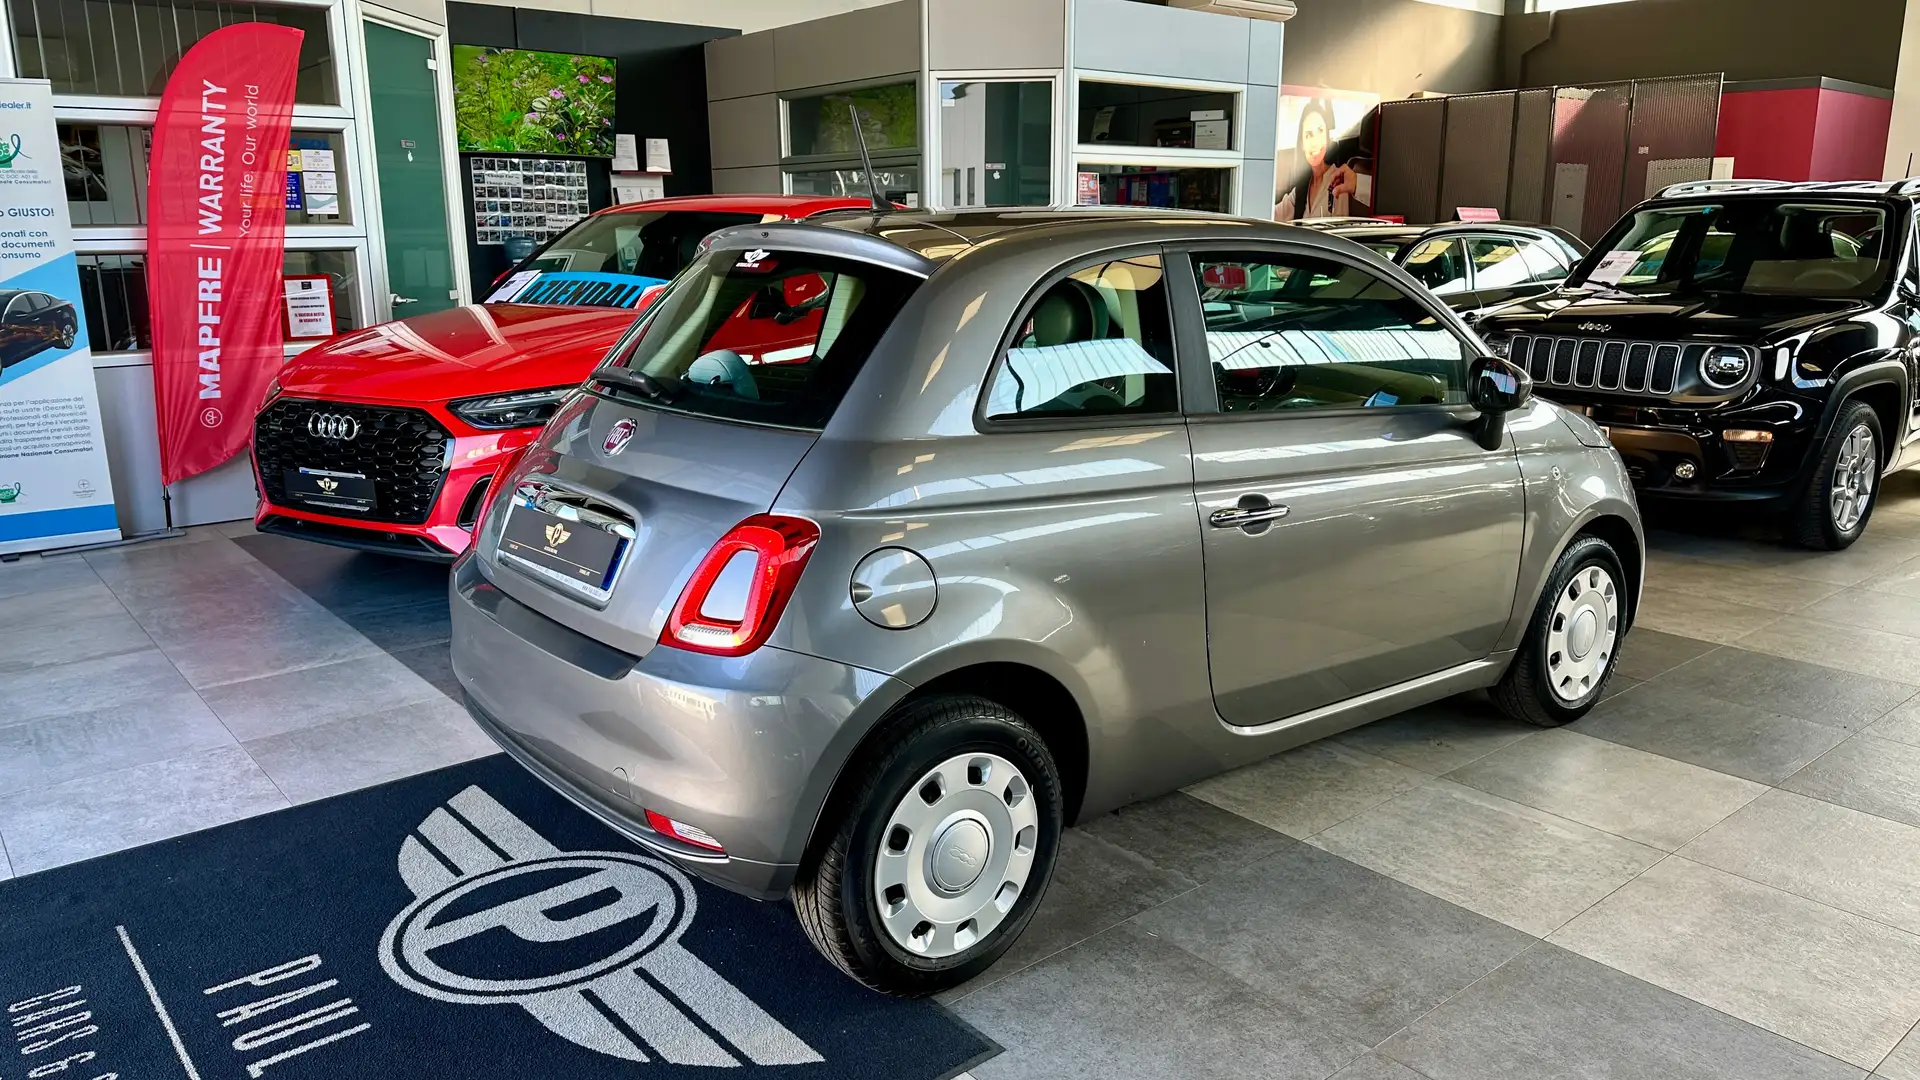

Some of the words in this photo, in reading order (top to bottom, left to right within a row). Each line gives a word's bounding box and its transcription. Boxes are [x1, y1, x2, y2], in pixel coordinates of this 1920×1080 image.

[244, 84, 259, 130] world
[198, 78, 227, 235] WARRANTY
[242, 136, 257, 165] Our
[7, 207, 55, 217] GIUSTO!
[239, 202, 253, 238] Your
[0, 230, 26, 238] onati
[1, 240, 56, 248] documenti
[198, 256, 222, 400] MAPFRE
[20, 449, 53, 457] Nazionale
[53, 446, 94, 455] Consumatori
[7, 984, 99, 1055] CARS
[202, 953, 373, 1079] PAUL
